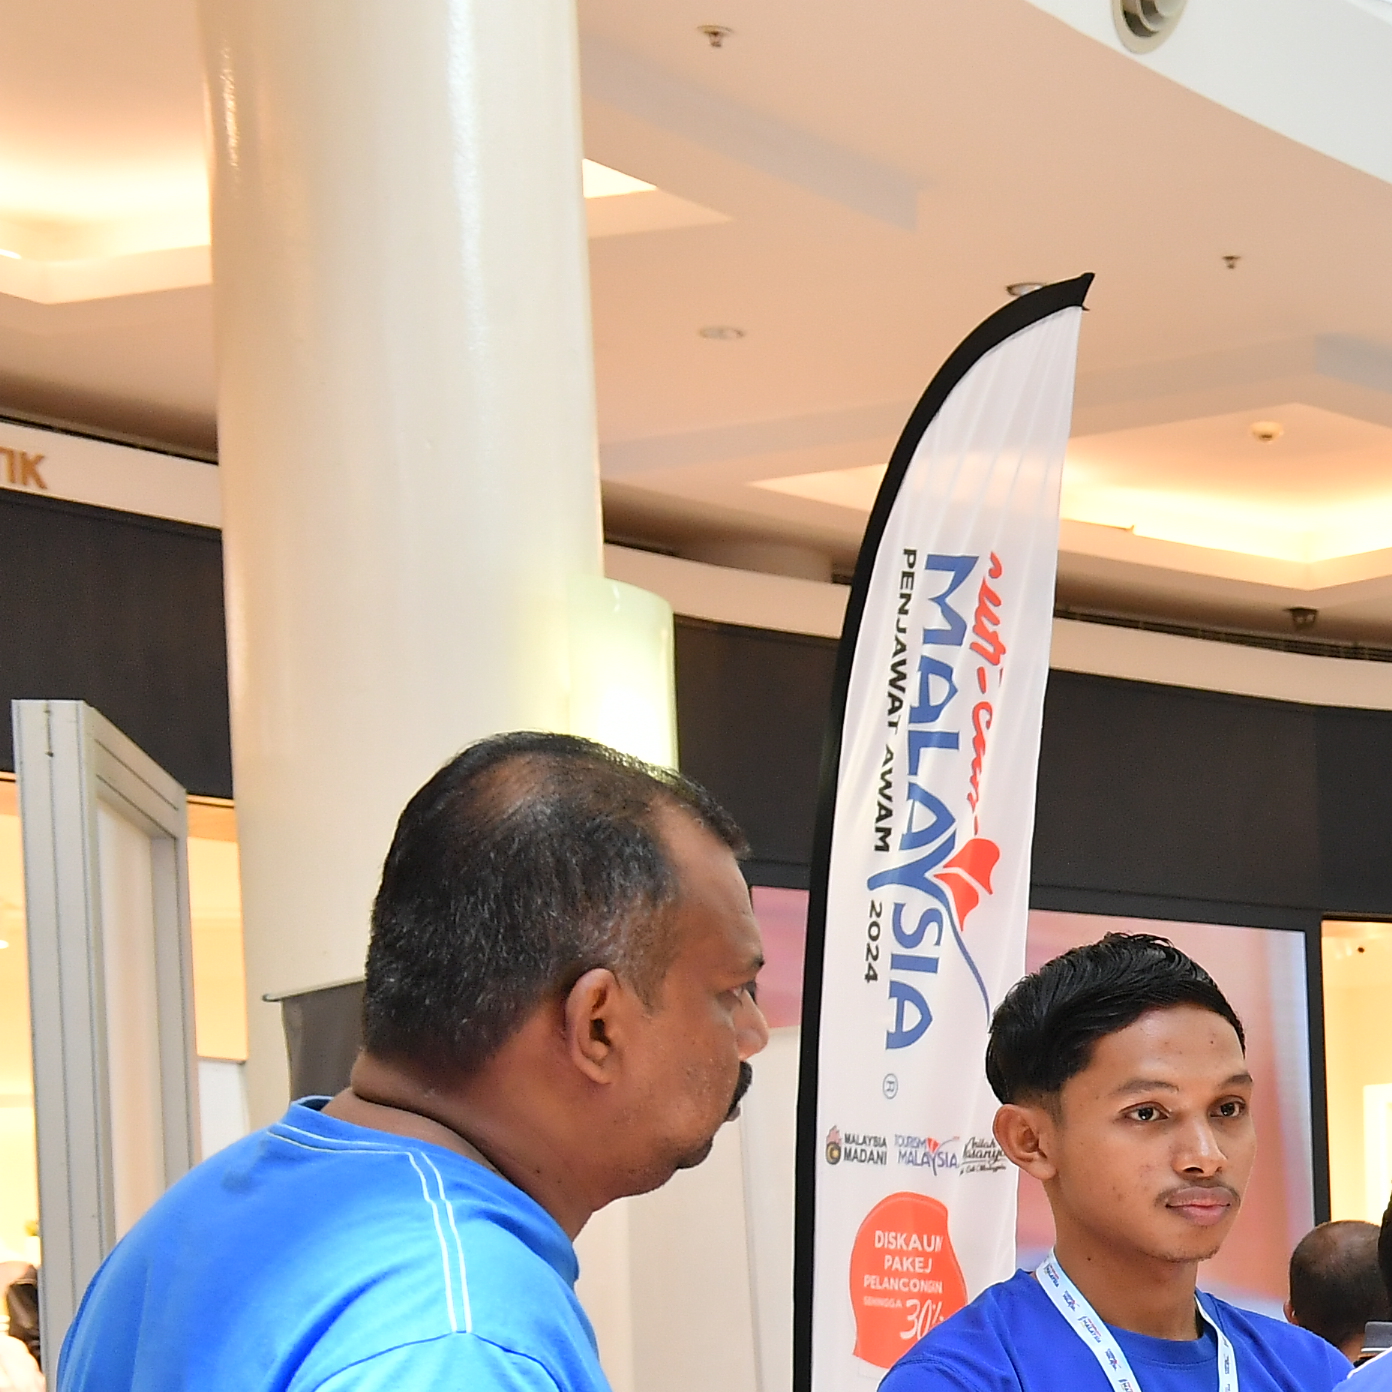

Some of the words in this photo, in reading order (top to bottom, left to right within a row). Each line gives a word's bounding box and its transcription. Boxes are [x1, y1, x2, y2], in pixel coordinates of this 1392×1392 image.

[887, 548, 917, 734] PENJAWAT
[867, 554, 980, 1050] MALAYSIA
[874, 743, 896, 853] AWAM
[864, 900, 882, 983] 2024
[844, 1132, 887, 1148] MALAYSIA
[895, 1134, 927, 1147] TOURISM
[844, 1148, 887, 1165] MADANI
[898, 1151, 959, 1176] MALAYSIA
[884, 1254, 932, 1273] PAKEJ
